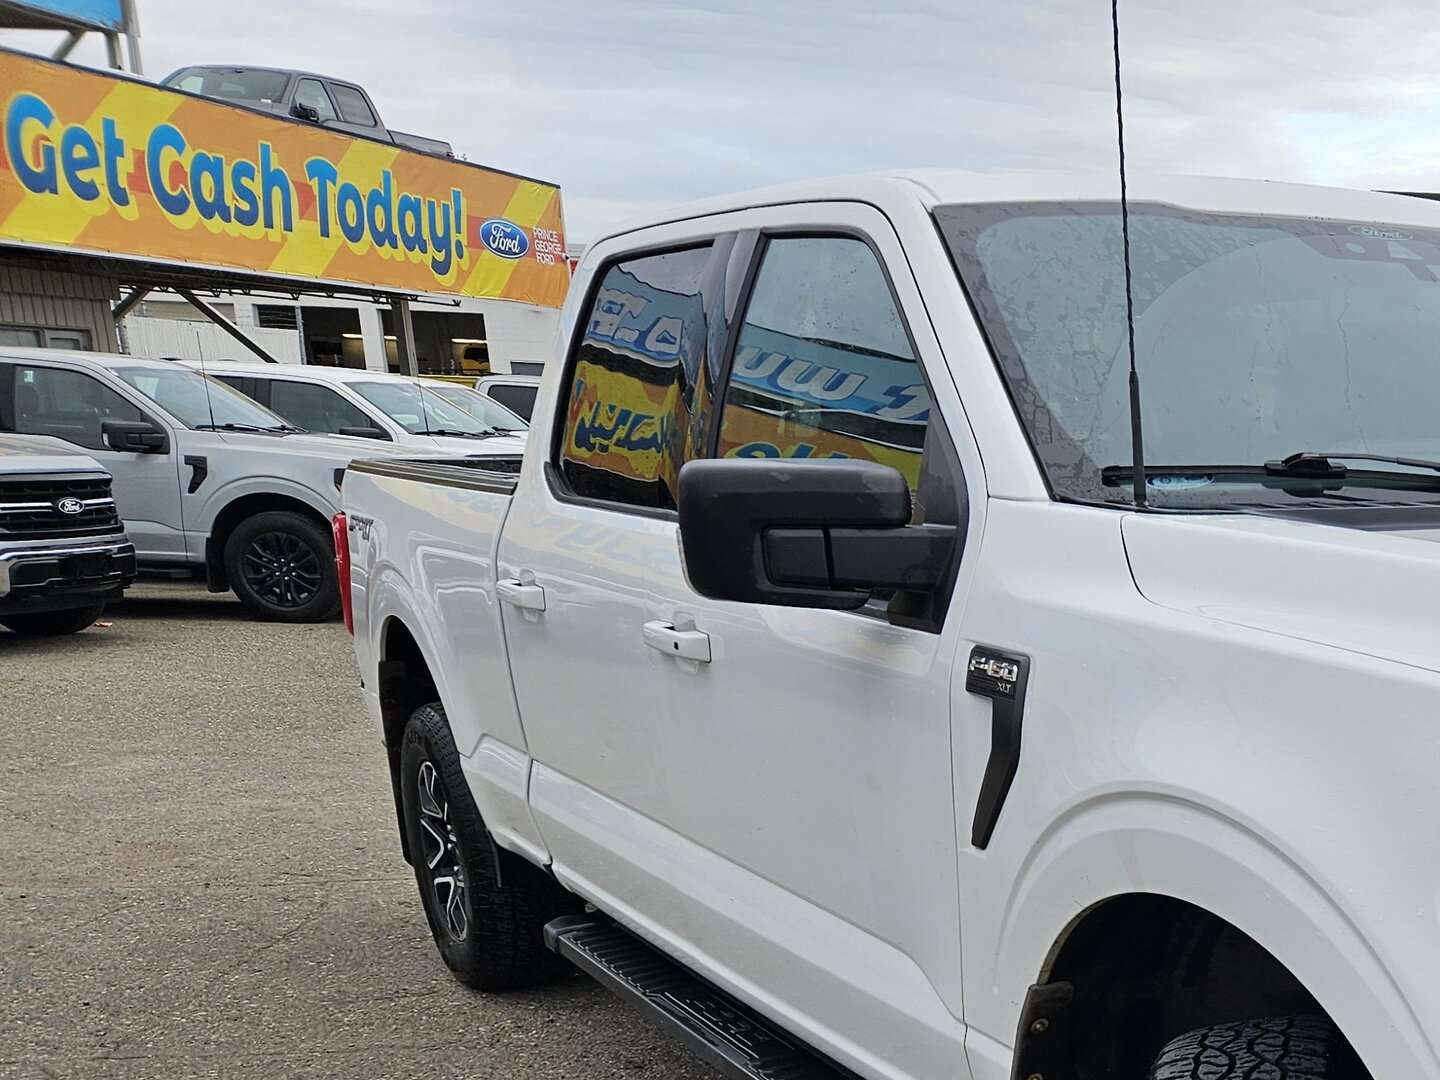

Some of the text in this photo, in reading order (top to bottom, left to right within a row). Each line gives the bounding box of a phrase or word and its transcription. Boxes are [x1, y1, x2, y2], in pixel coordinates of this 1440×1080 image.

[5, 93, 464, 276] Get Cash Today!
[532, 226, 559, 242] PRINCE
[534, 240, 562, 256] GEORGE
[536, 252, 556, 265] FORD
[997, 682, 1012, 693] XLT
